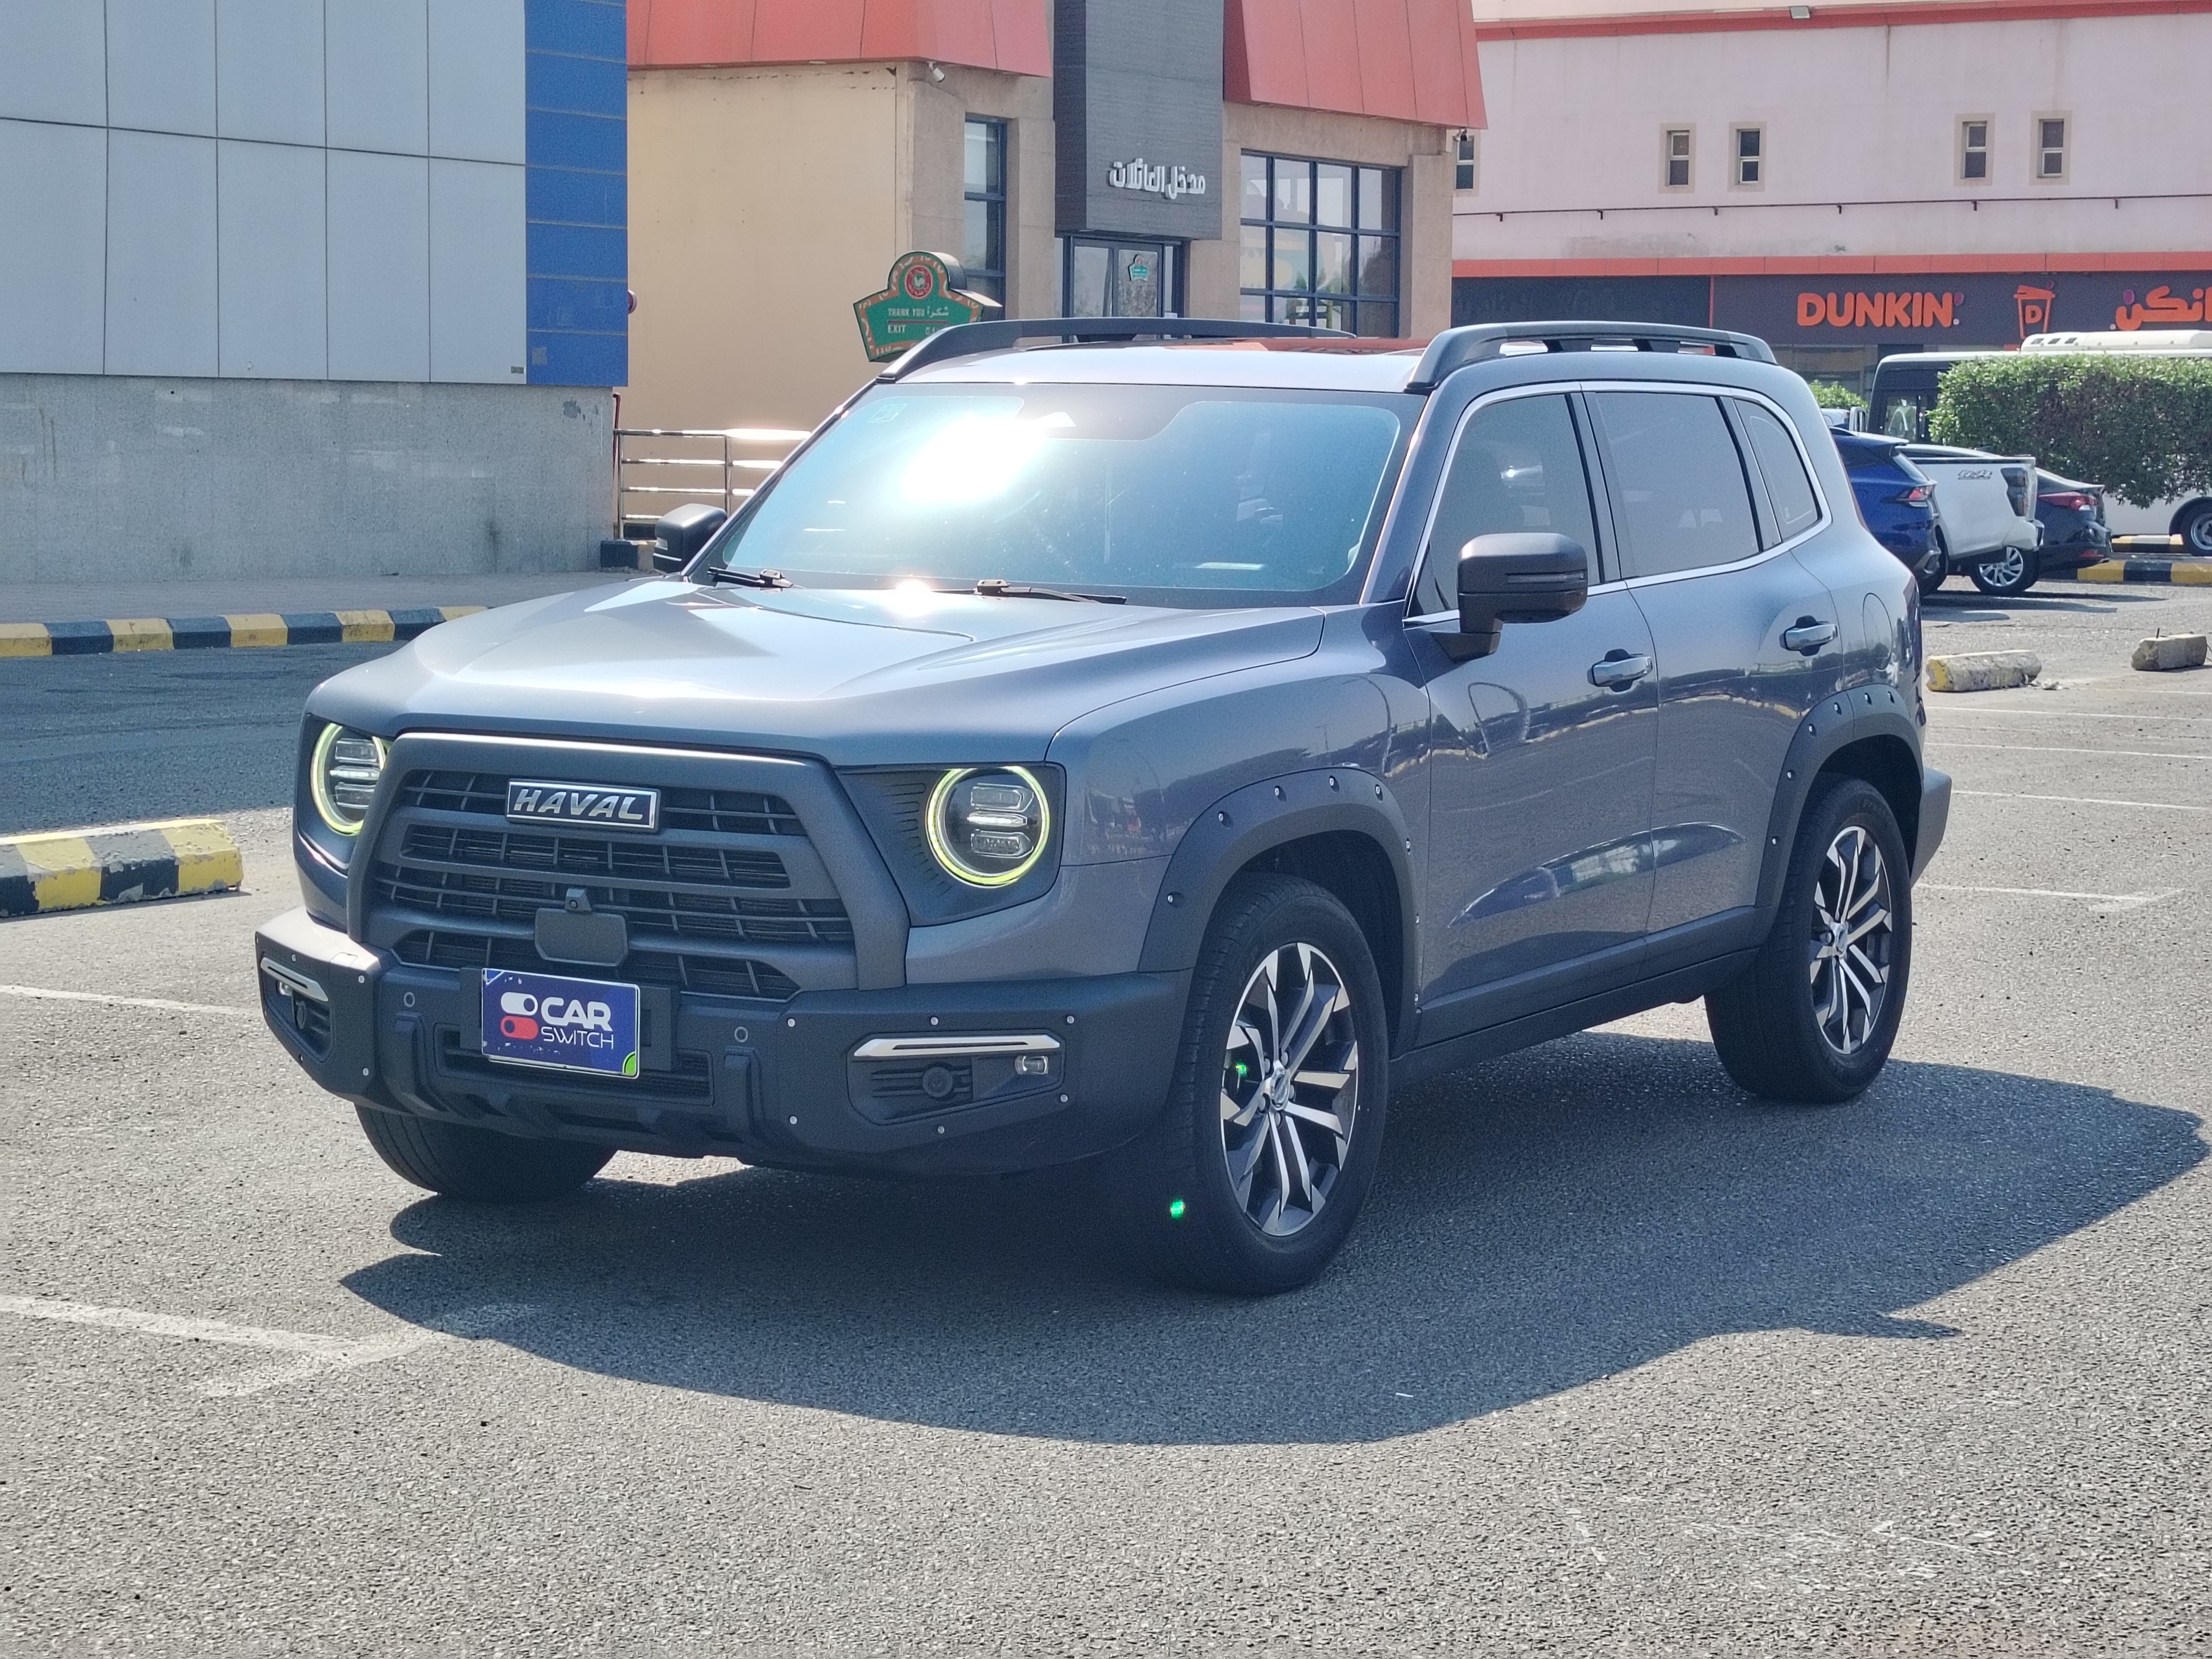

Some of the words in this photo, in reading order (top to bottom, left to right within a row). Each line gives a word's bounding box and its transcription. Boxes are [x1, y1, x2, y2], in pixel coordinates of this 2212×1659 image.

[1109, 158, 1165, 192] العائلات
[1165, 166, 1206, 199] مدخل
[912, 308, 925, 317] YOU
[2025, 305, 2043, 324] D
[2115, 285, 2212, 331] انكن
[888, 325, 906, 333] EXIT
[514, 789, 643, 820] HAVAL
[541, 997, 613, 1032] CAR
[541, 1026, 614, 1050] SWITCH
